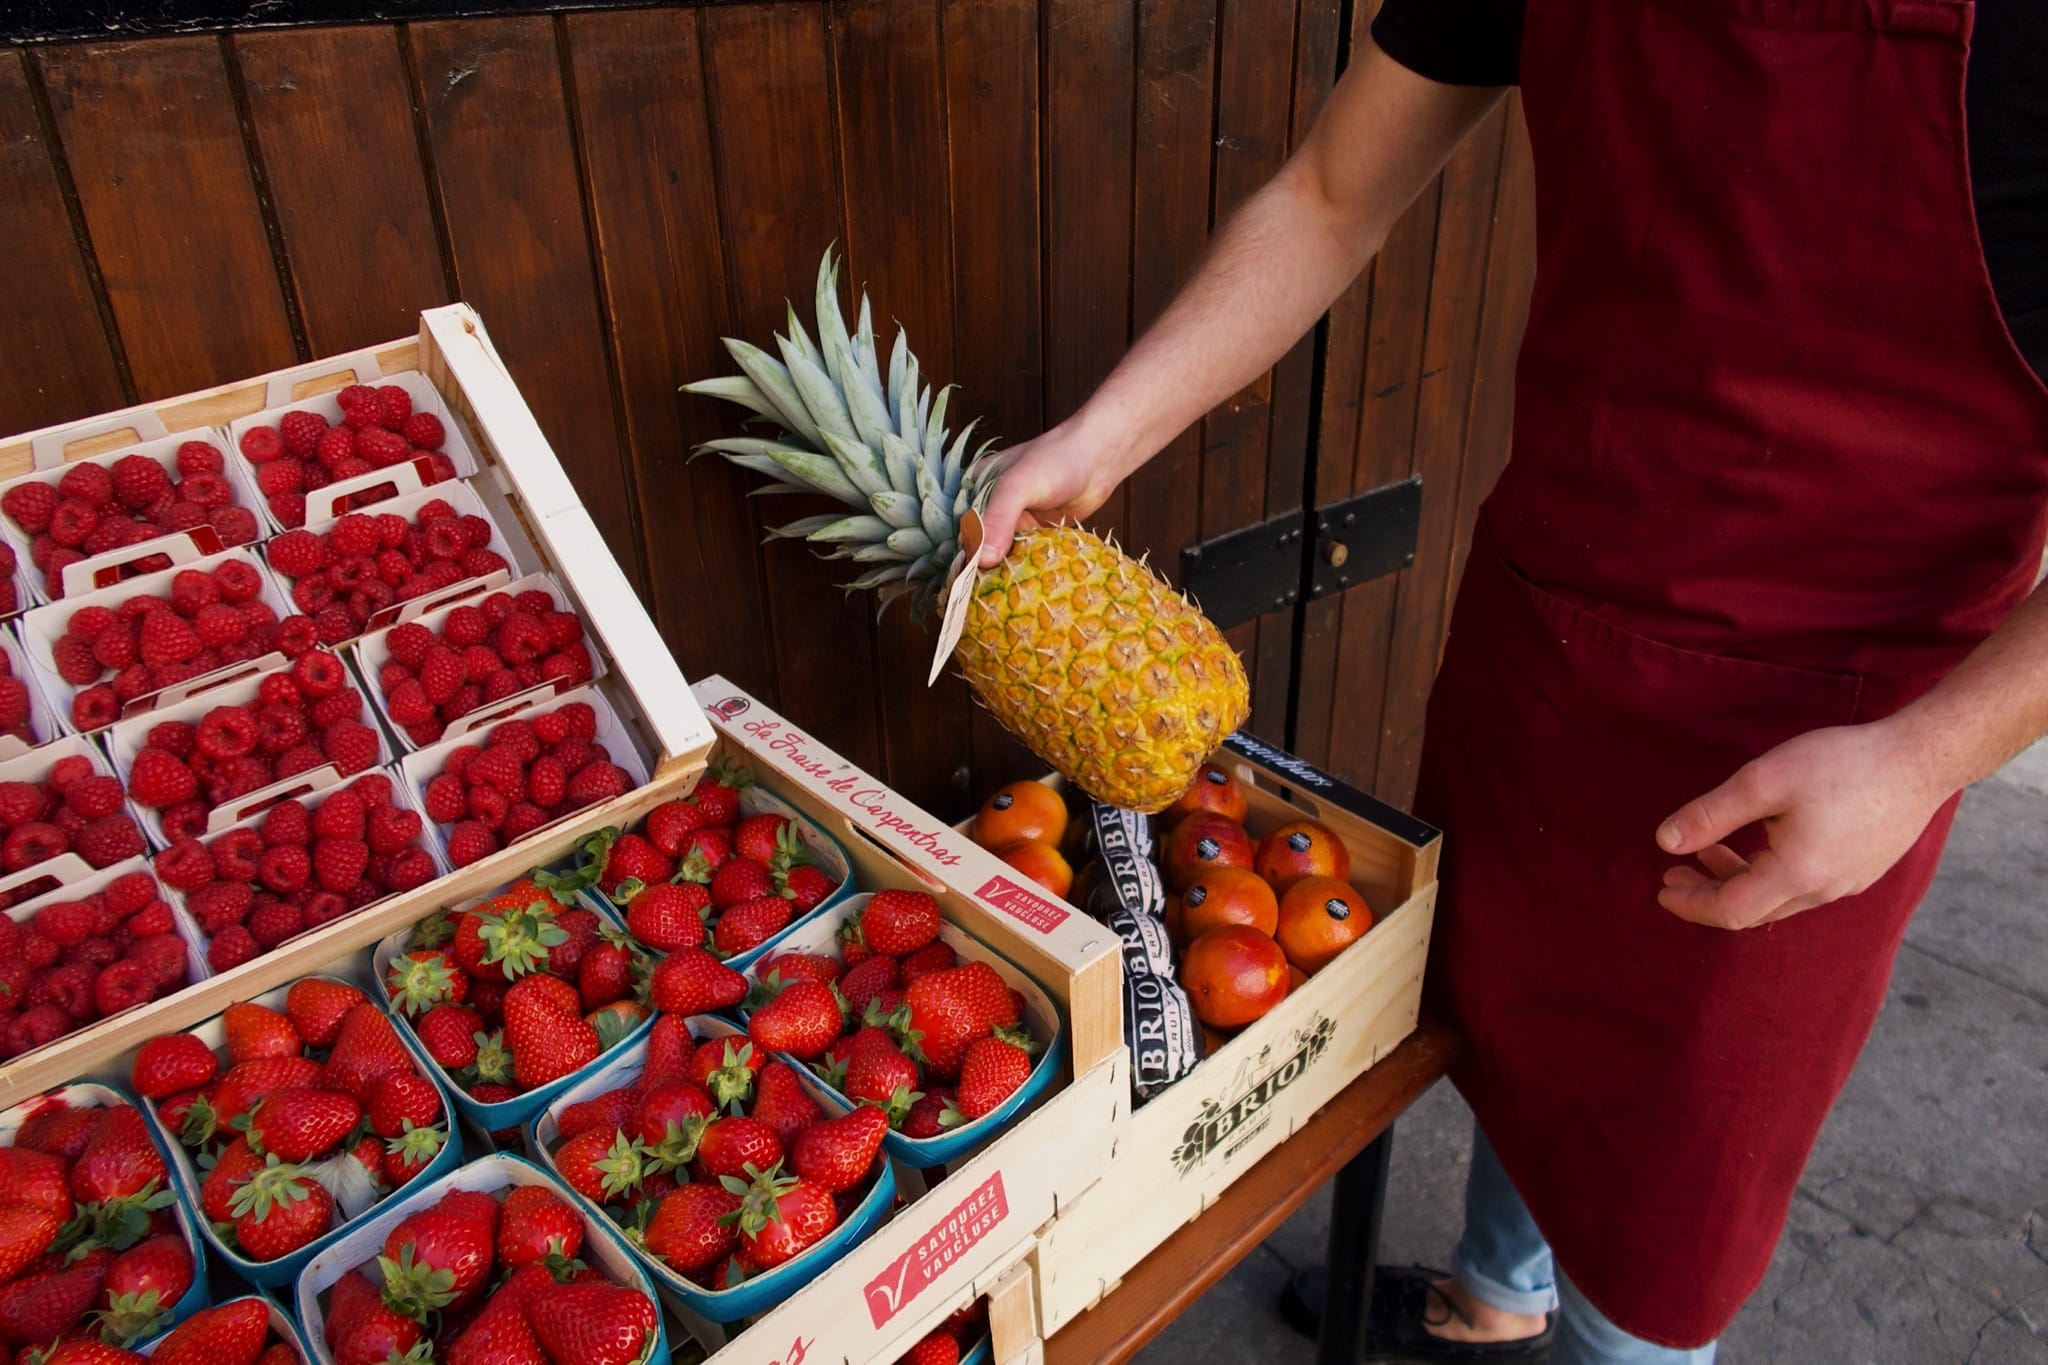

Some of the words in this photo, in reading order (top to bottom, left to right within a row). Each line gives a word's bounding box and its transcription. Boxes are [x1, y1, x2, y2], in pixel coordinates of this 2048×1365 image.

[743, 720, 781, 740] La
[769, 732, 831, 780] Fraise
[827, 774, 855, 793] de
[849, 788, 963, 867] Carpentras
[1004, 900, 1051, 930] VAUCLUSE
[1014, 892, 1062, 921] SAVOUREZ
[1135, 981, 1166, 1071] BRIO
[1215, 1058, 1301, 1143] BRIO
[918, 1184, 997, 1261] SAVOUREZ
[922, 1207, 1001, 1280] VAUCLUSE
[954, 1223, 967, 1240] LE
